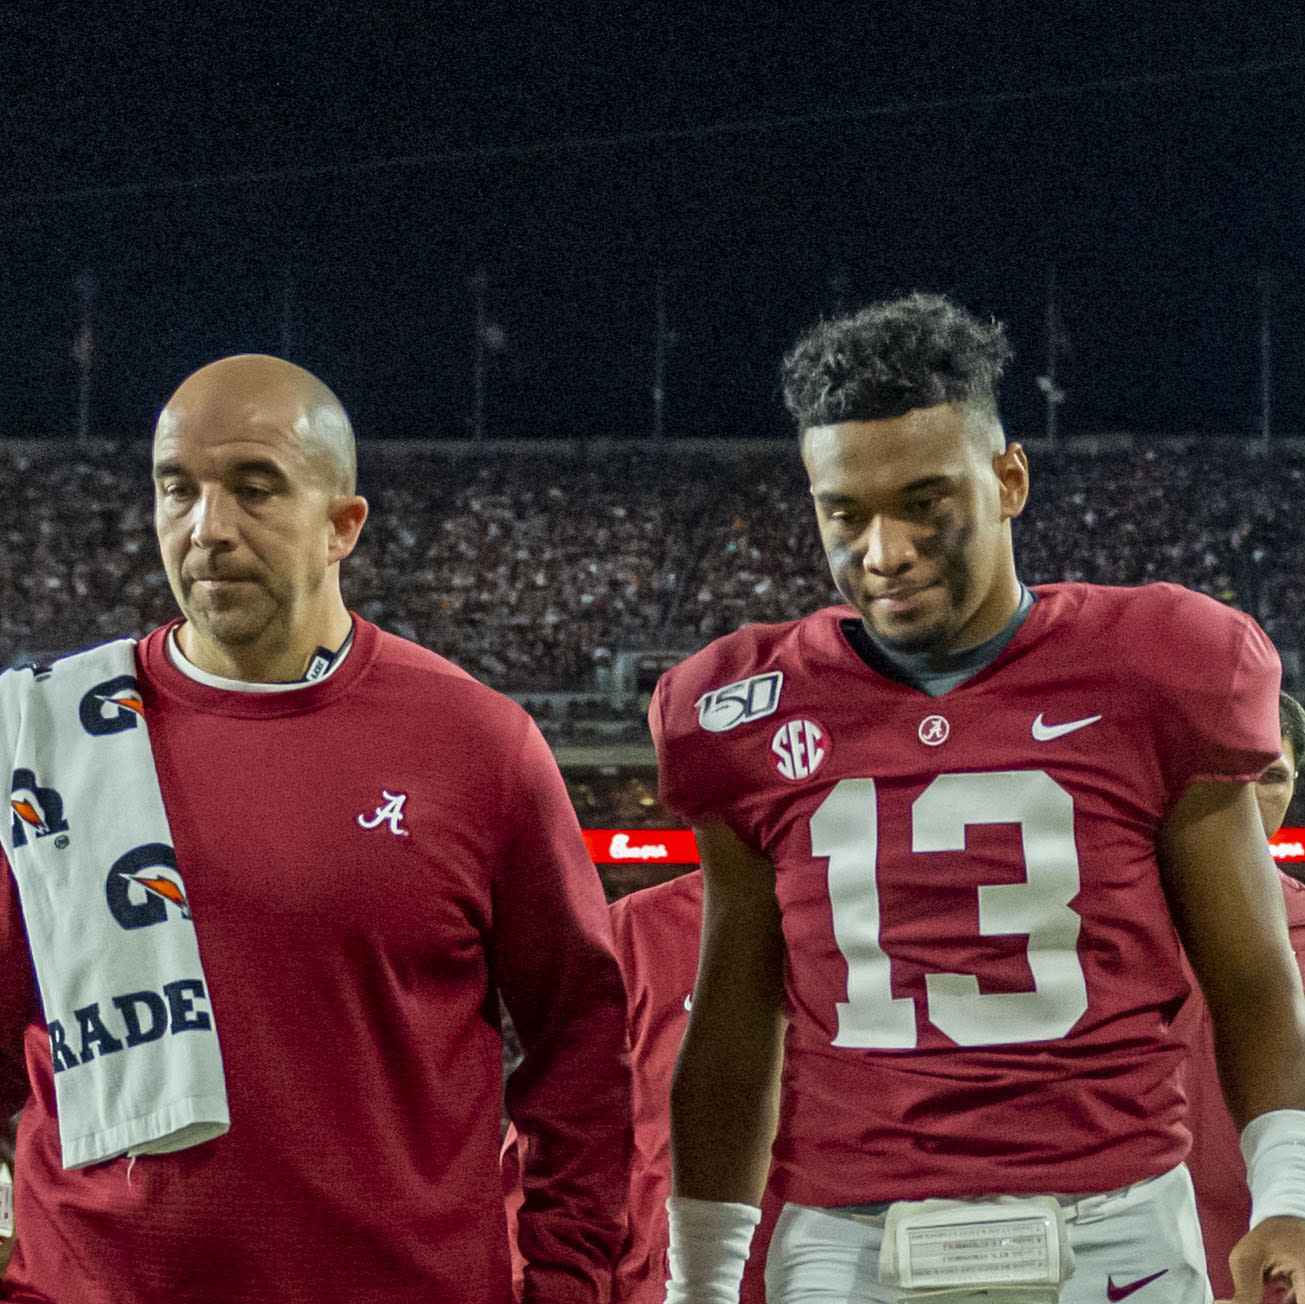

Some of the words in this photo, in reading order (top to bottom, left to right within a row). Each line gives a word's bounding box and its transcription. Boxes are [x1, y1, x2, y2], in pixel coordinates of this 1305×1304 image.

[697, 672, 783, 732] 150
[772, 720, 824, 779] SEC
[809, 769, 1088, 1049] 13
[48, 979, 212, 1074] RADE
